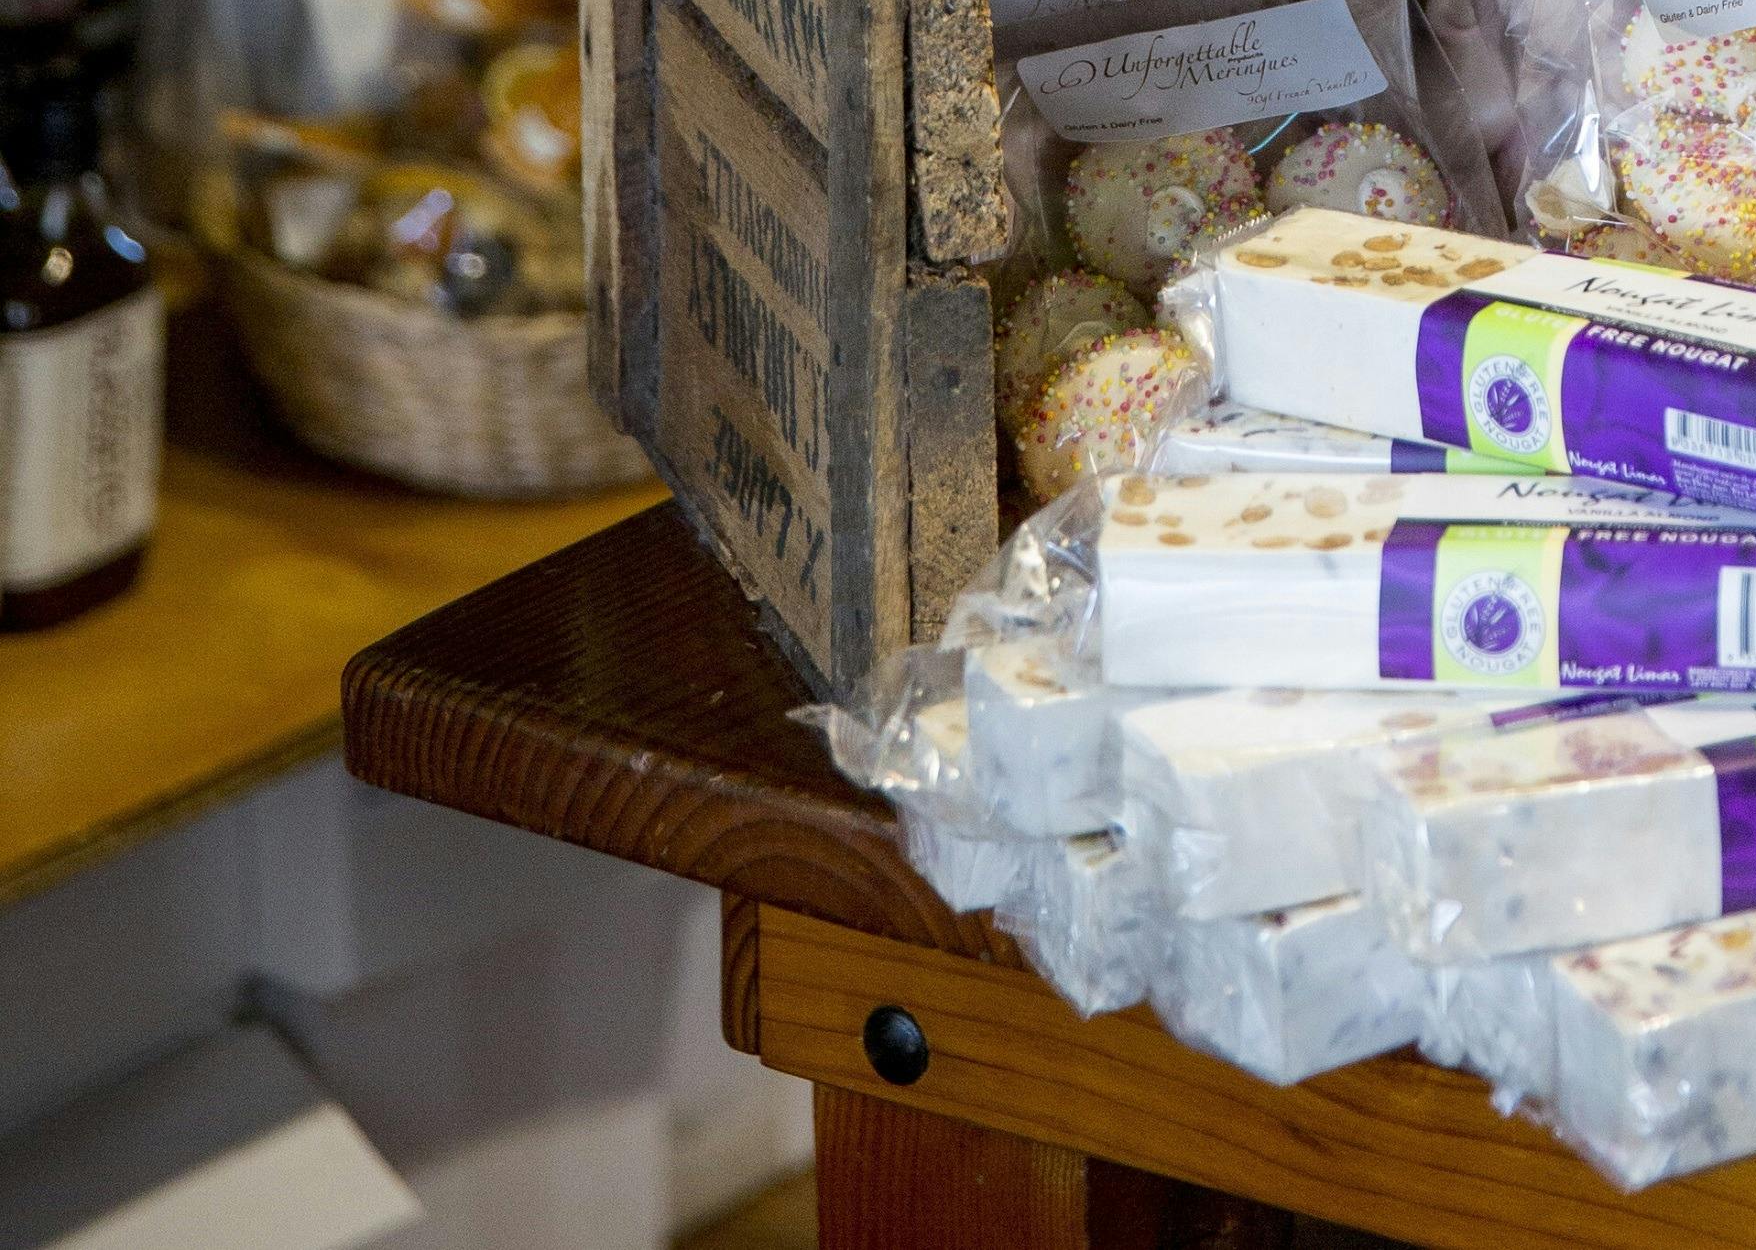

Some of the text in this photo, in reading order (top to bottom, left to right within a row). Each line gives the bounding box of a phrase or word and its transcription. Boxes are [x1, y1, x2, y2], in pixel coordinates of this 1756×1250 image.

[1659, 9, 1687, 25] Gluten
[1696, 2, 1720, 18] Dairy
[1103, 21, 1262, 100] Unforgettable
[1157, 53, 1299, 97] Meringues
[1587, 325, 1749, 371] FREE NOUGAT
[1474, 361, 1516, 415] GLUTEN
[1484, 419, 1549, 454] NOUGAT
[1578, 528, 1650, 543] FREE
[1562, 662, 1624, 684] Nougat
